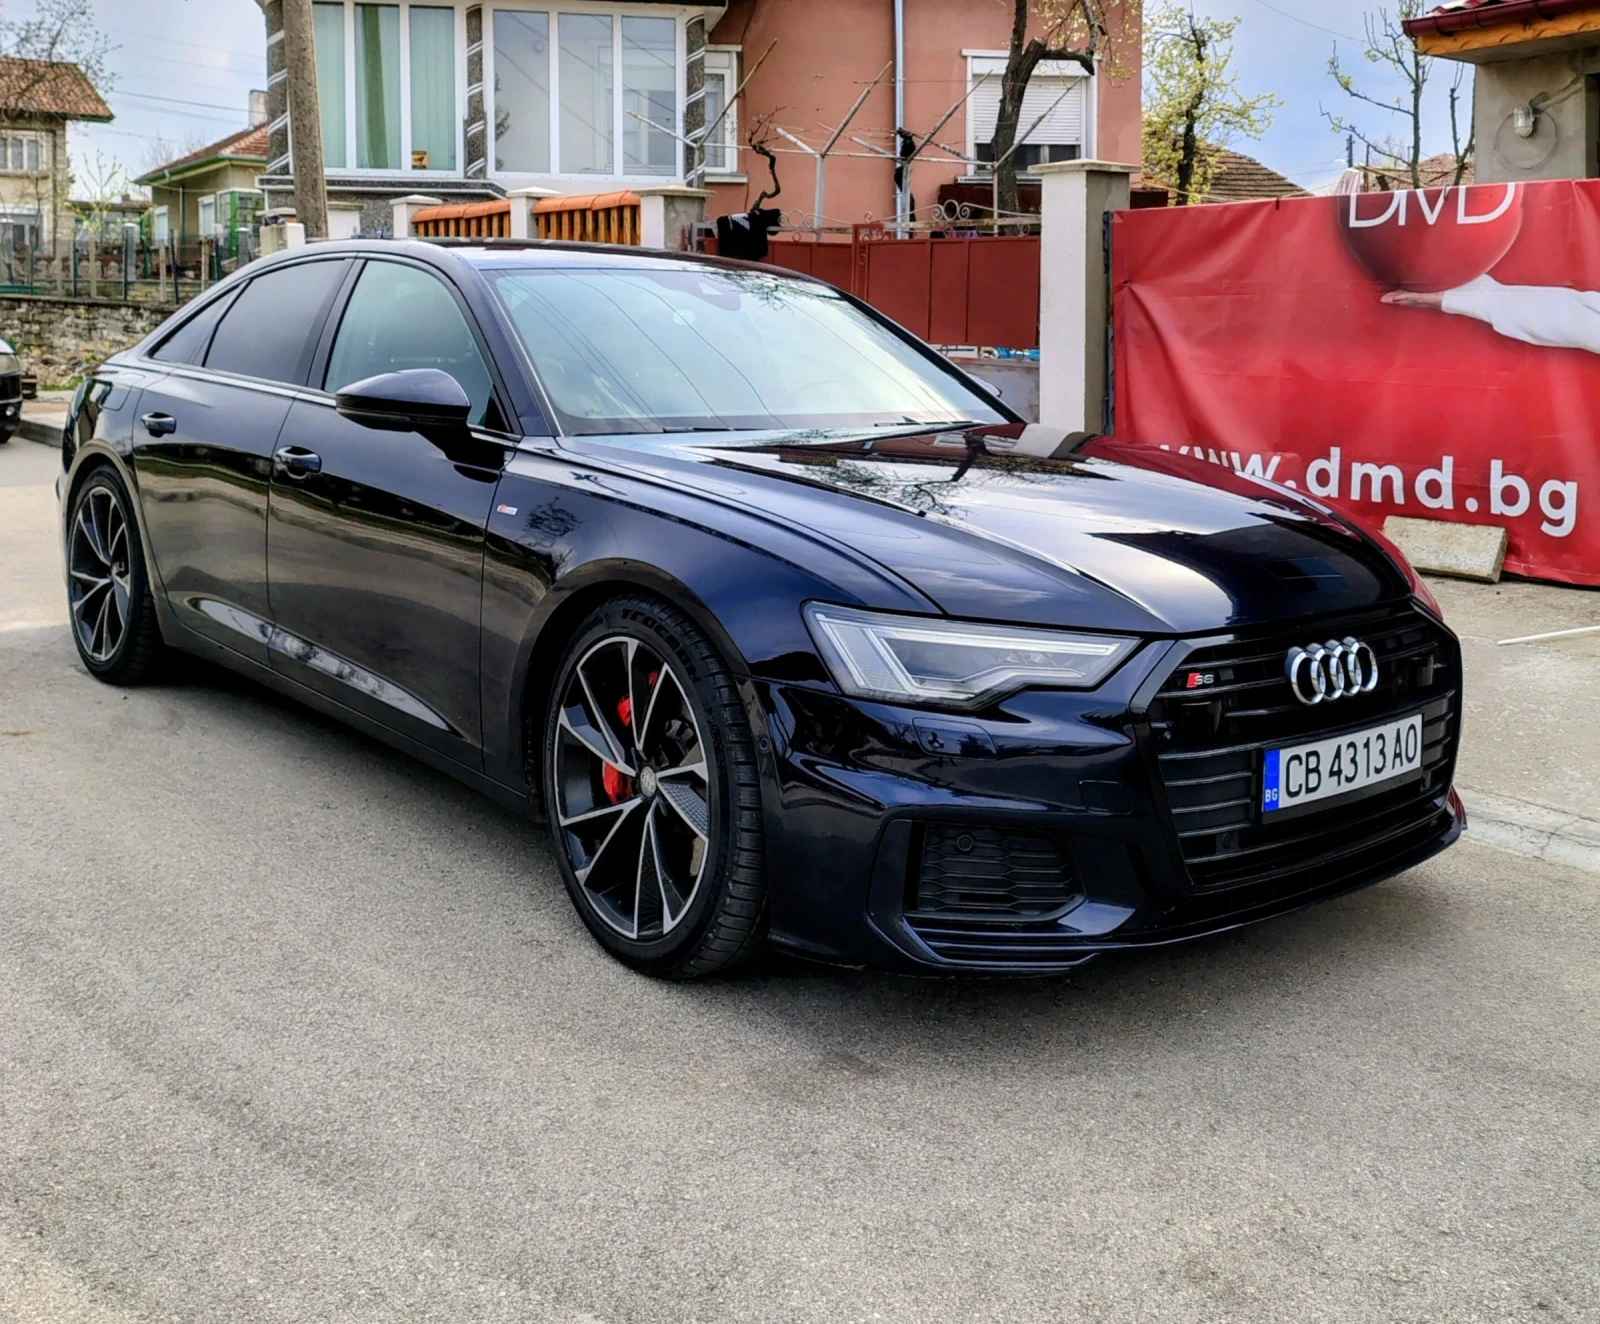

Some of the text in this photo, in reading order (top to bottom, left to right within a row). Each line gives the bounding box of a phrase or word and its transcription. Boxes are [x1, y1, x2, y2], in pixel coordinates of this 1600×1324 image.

[1285, 750, 1322, 798] CB
[1328, 733, 1387, 786] 4313
[1265, 788, 1278, 802] BG
